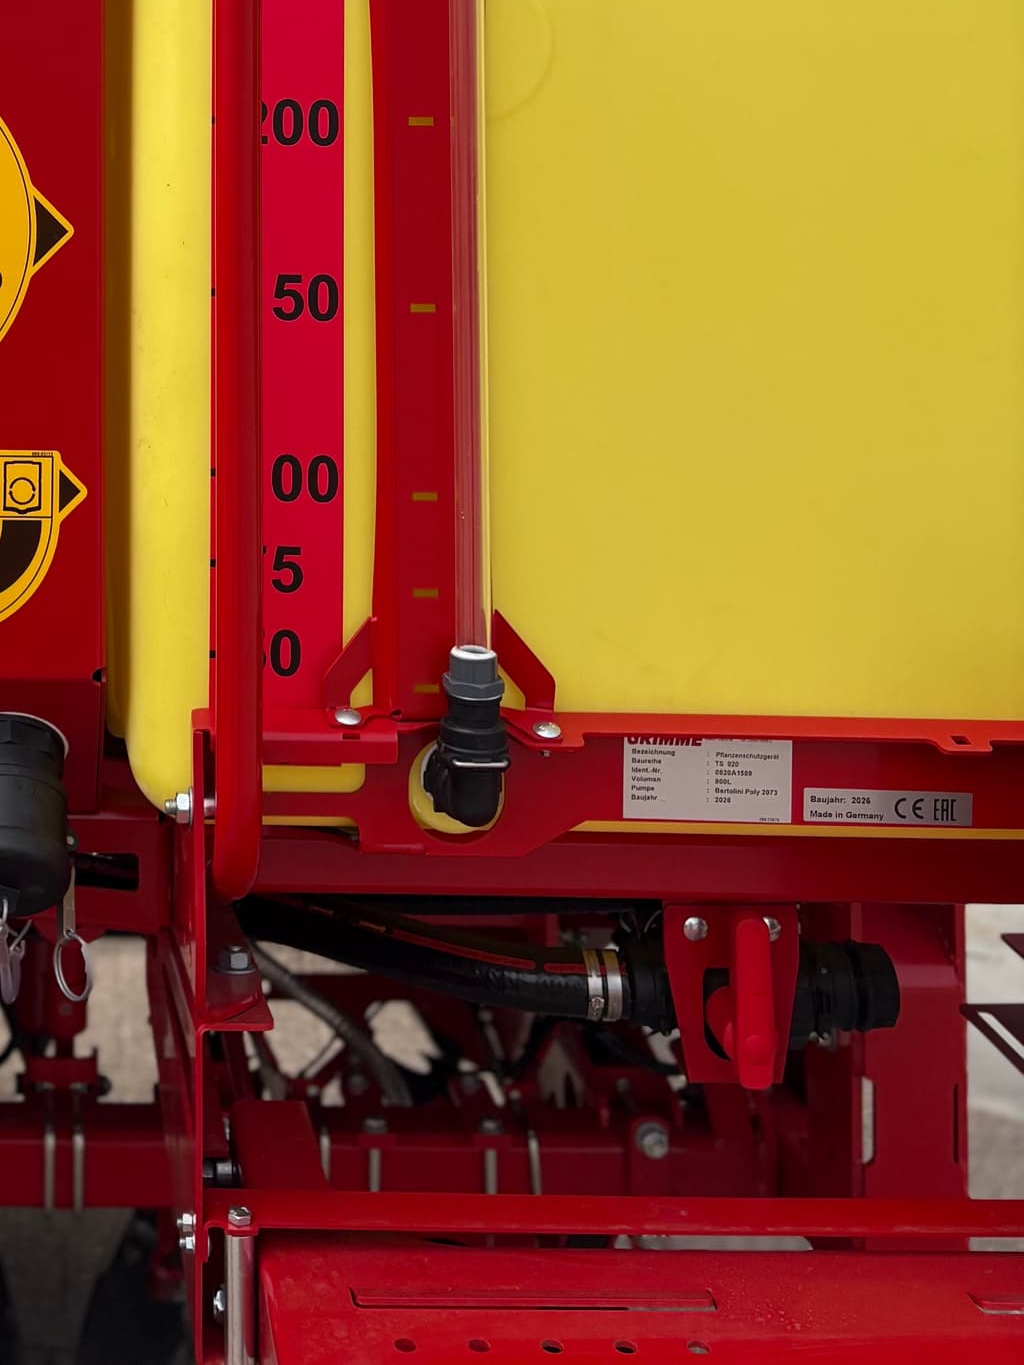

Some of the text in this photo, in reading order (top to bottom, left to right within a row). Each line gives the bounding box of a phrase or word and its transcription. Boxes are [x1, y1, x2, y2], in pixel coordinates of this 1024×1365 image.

[262, 99, 340, 146] 00
[272, 274, 340, 322] 50
[271, 454, 339, 504] 00
[263, 545, 304, 594] 5
[262, 629, 302, 677] 0
[631, 748, 780, 761] Bezeichnung Pflanzenschutzgerät
[631, 775, 662, 783] Volumen
[631, 784, 655, 792] Pumpe
[714, 787, 744, 795] Bertolini
[744, 788, 760, 797] Poly
[631, 793, 731, 804] Baujahr 2026
[810, 795, 847, 805] Baujahr:
[851, 796, 871, 805] 2026
[809, 810, 884, 822] Made in Germany
